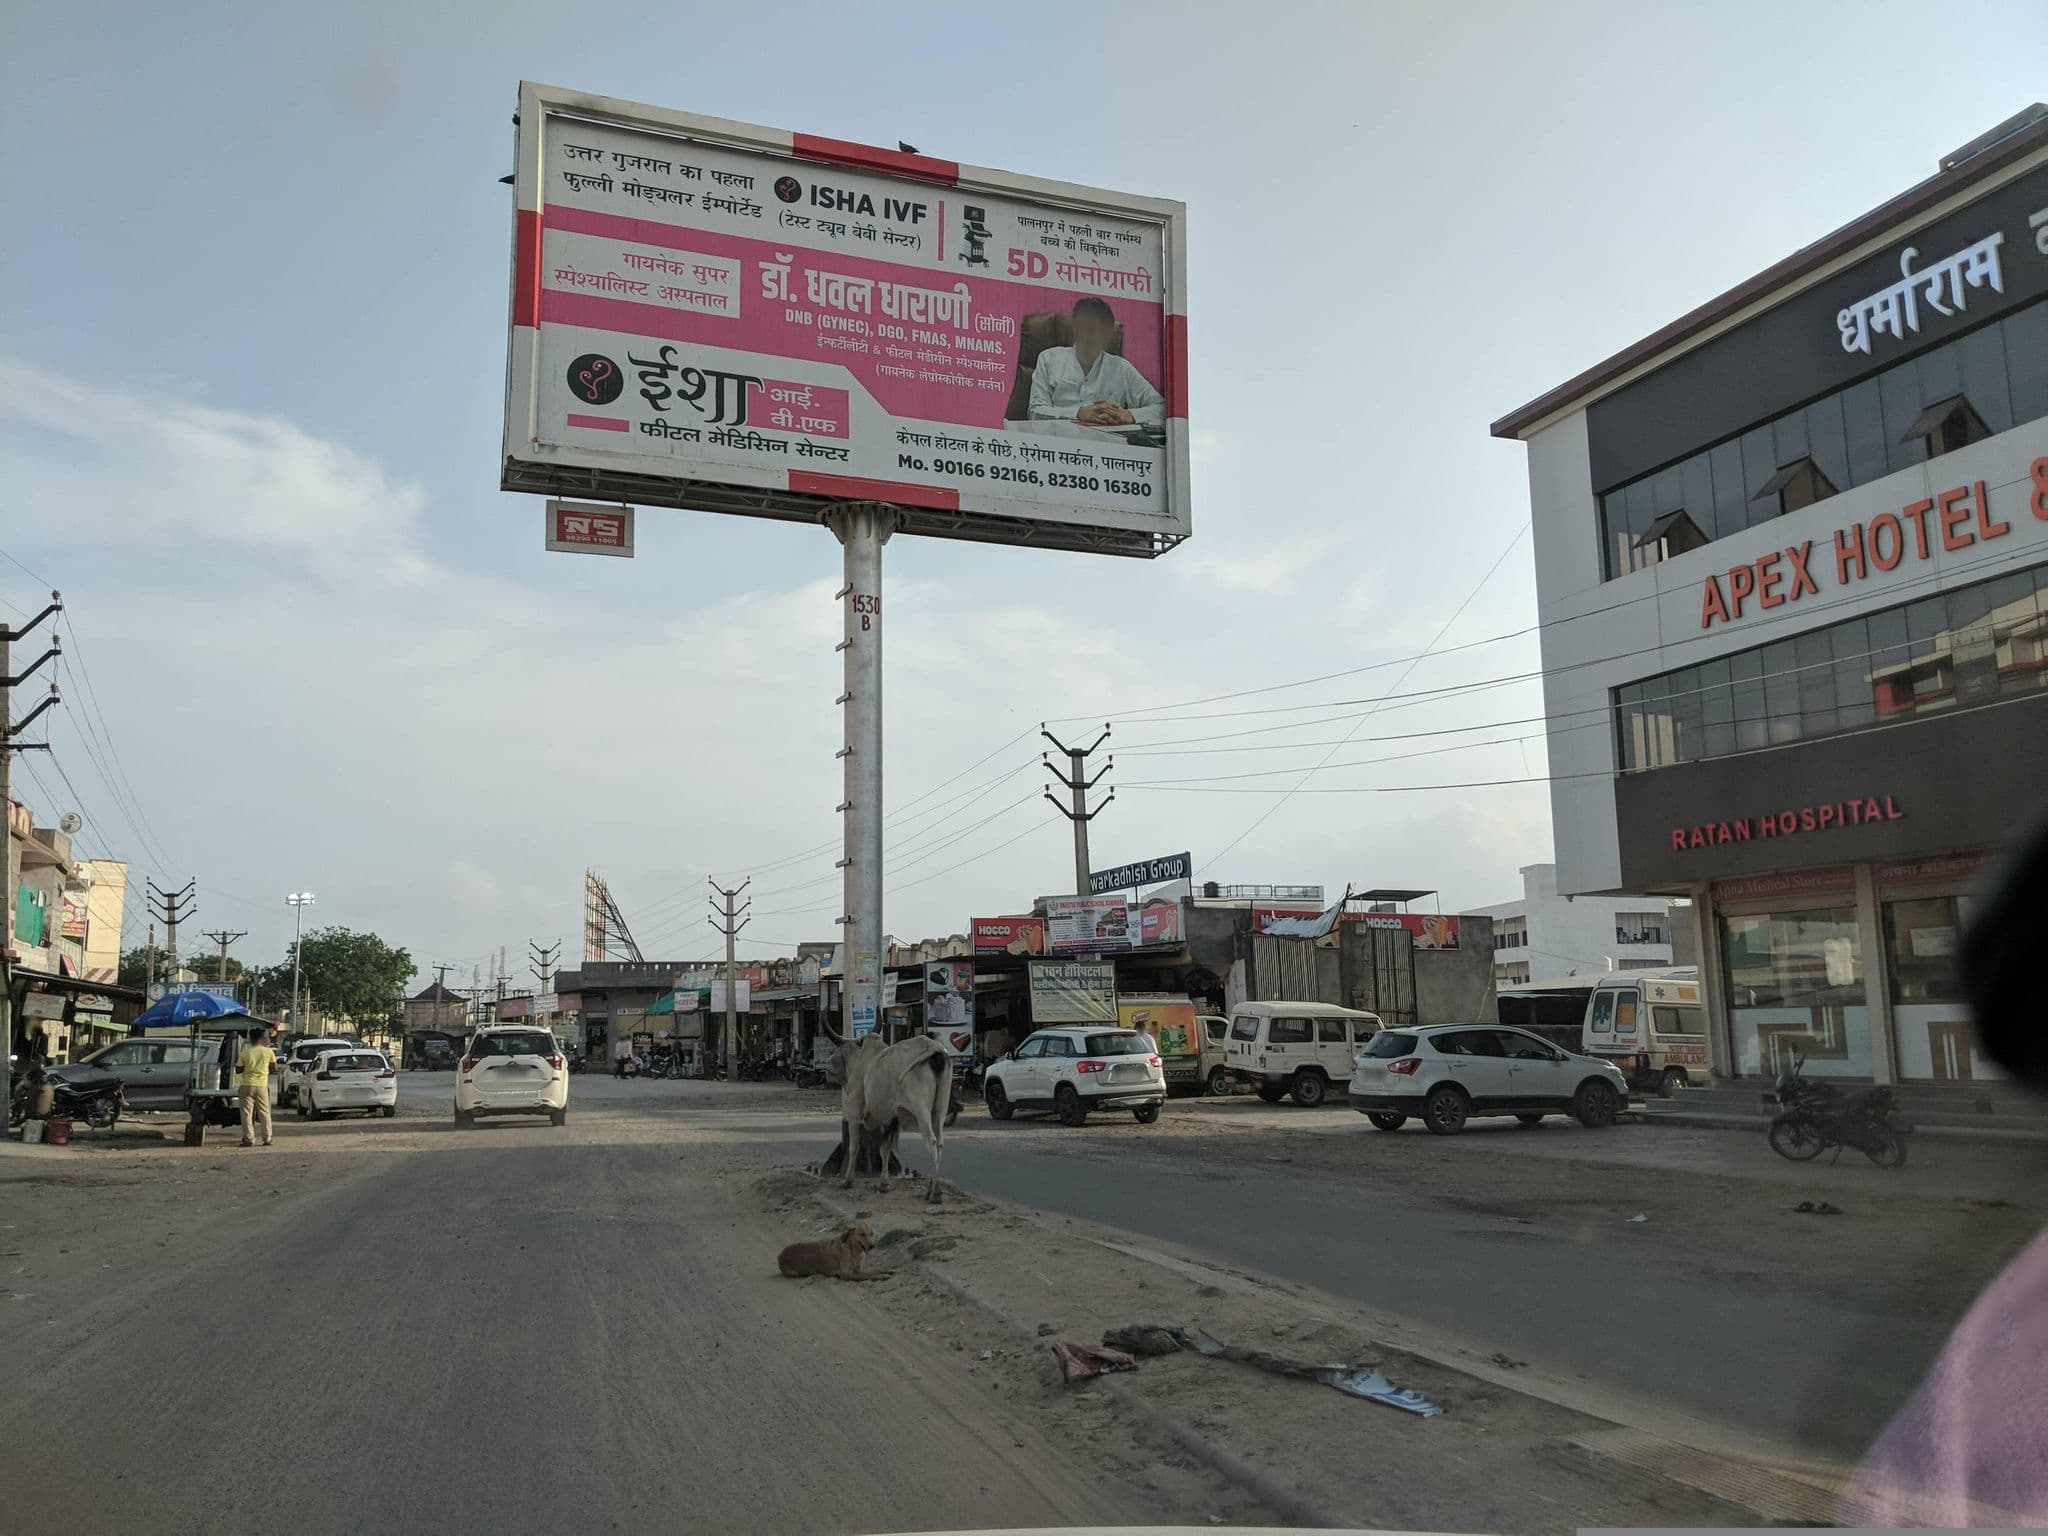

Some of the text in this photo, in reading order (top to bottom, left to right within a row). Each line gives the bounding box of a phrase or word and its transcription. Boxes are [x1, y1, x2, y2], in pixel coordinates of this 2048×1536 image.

[563, 142, 755, 190] उत्तर गुजरात का पहला
[564, 168, 613, 194] फुल्ली
[702, 191, 762, 218] ईम्पोर्टेड
[810, 184, 928, 225] ISHA IVF
[778, 208, 811, 230] (टेस्ट
[883, 227, 921, 251] सेन्टर)
[1018, 216, 1054, 233] पालनपुर
[1058, 219, 1066, 233] में
[1069, 223, 1092, 238] पहली
[1064, 238, 1076, 251] की
[555, 265, 728, 310] स्पेश्यालिस्ट अस्पताल
[623, 251, 730, 285] गायनेक सुपर
[1007, 247, 1152, 294] 5D सोनोग्राफी
[758, 252, 797, 302] डॉ.
[805, 269, 874, 315] धवल
[879, 282, 971, 330] धाराणी
[1837, 231, 2004, 355] धर्माराम
[785, 308, 1006, 355] DNB (GYNEC), DGO, FMAS, MNAMS.
[873, 345, 881, 355] &
[627, 345, 765, 427] ईशा
[876, 363, 915, 379] (गायनेक
[770, 387, 820, 409] आई.
[640, 418, 849, 462] फीटल मेडिसिन सेन्टर
[770, 410, 838, 433] वी.एफ
[898, 453, 1152, 497] Mo. 90166 92166, 82380 16380
[935, 433, 969, 453] होटल
[971, 436, 984, 454] के
[988, 439, 1017, 461] पीछे,
[1058, 448, 1099, 469] सर्कल,
[1102, 455, 1152, 478] पालनपुर
[1702, 540, 1818, 628] APEX
[1834, 480, 2010, 585] HOTEL
[852, 594, 880, 615] 1530
[861, 614, 871, 631] B
[1672, 795, 1904, 851] RATAN HOSPITAL
[1090, 859, 1183, 892] warkadhish Group
[978, 925, 1011, 936] HOCCO
[1366, 917, 1402, 929] HOCCO
[1664, 1054, 1708, 1064] AMBULANC
